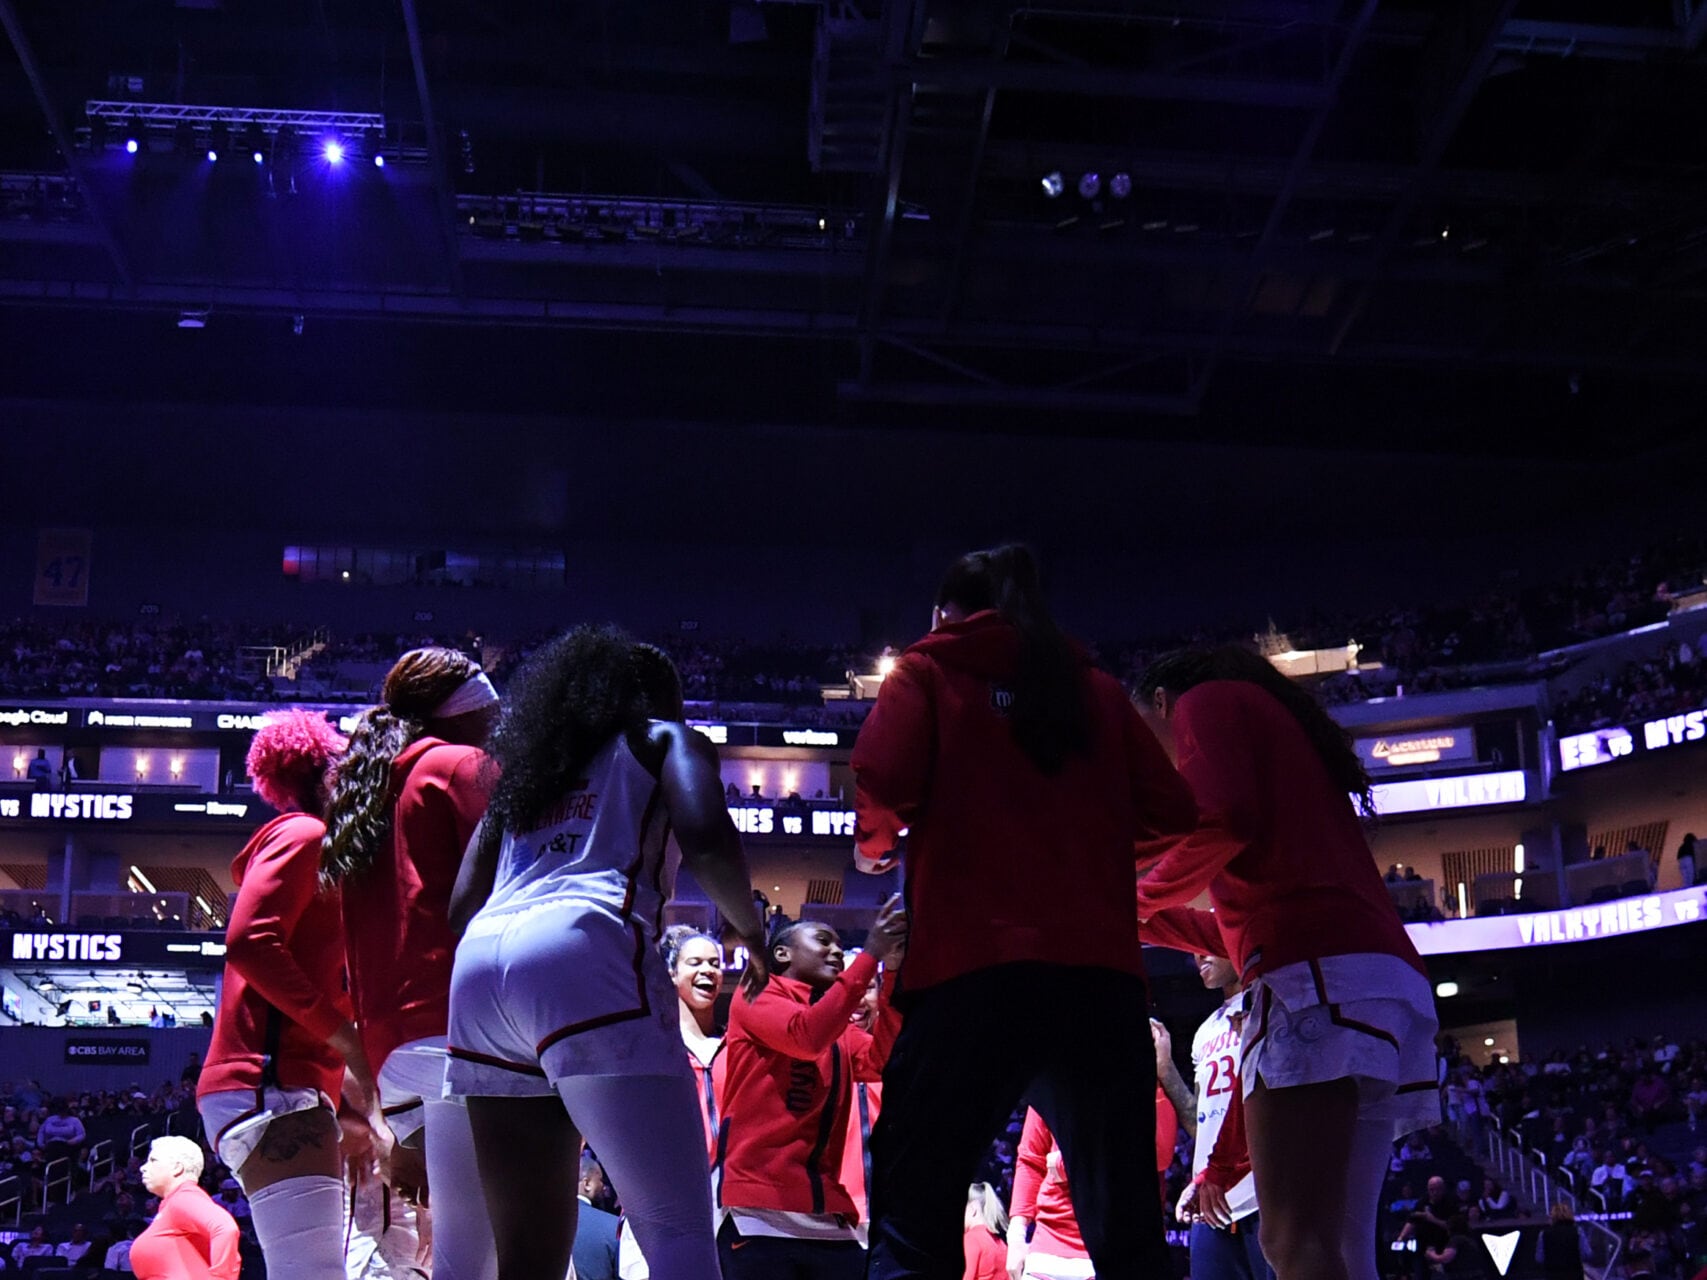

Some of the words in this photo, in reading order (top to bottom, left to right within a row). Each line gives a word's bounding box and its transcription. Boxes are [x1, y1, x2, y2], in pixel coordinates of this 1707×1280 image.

[1644, 709, 1707, 749] MYS
[31, 793, 133, 818] MYSTICS
[1517, 896, 1662, 944] VALKYRIES
[13, 934, 121, 960] MYSTICS
[77, 1046, 97, 1055] CBS
[98, 1046, 118, 1055] BAY
[117, 1046, 146, 1056] AREA
[1206, 1055, 1237, 1098] 23
